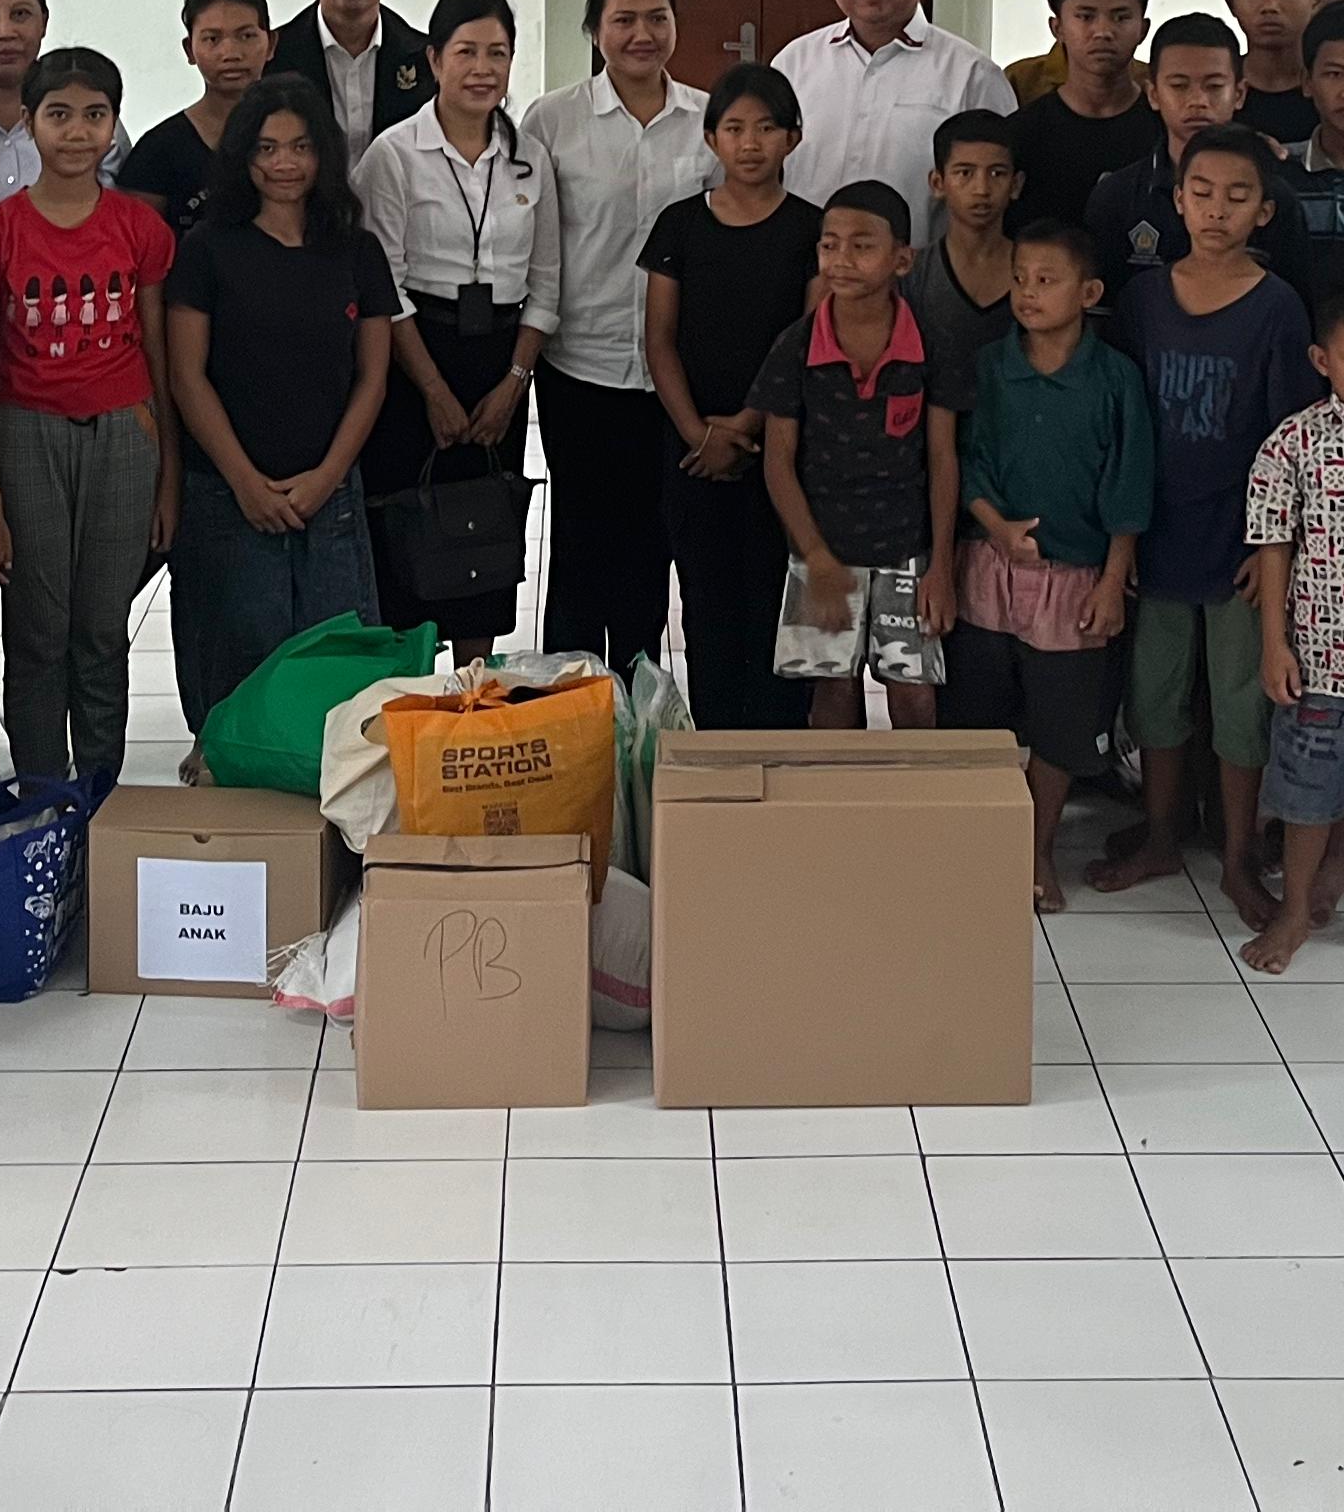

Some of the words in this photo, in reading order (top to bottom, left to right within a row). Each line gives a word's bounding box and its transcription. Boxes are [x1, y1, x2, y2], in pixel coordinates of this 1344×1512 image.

[441, 738, 548, 763] SPORTS
[441, 753, 552, 780] STATION
[179, 903, 225, 917] BAJU
[177, 927, 227, 941] ANAK
[422, 909, 522, 1021] PB
